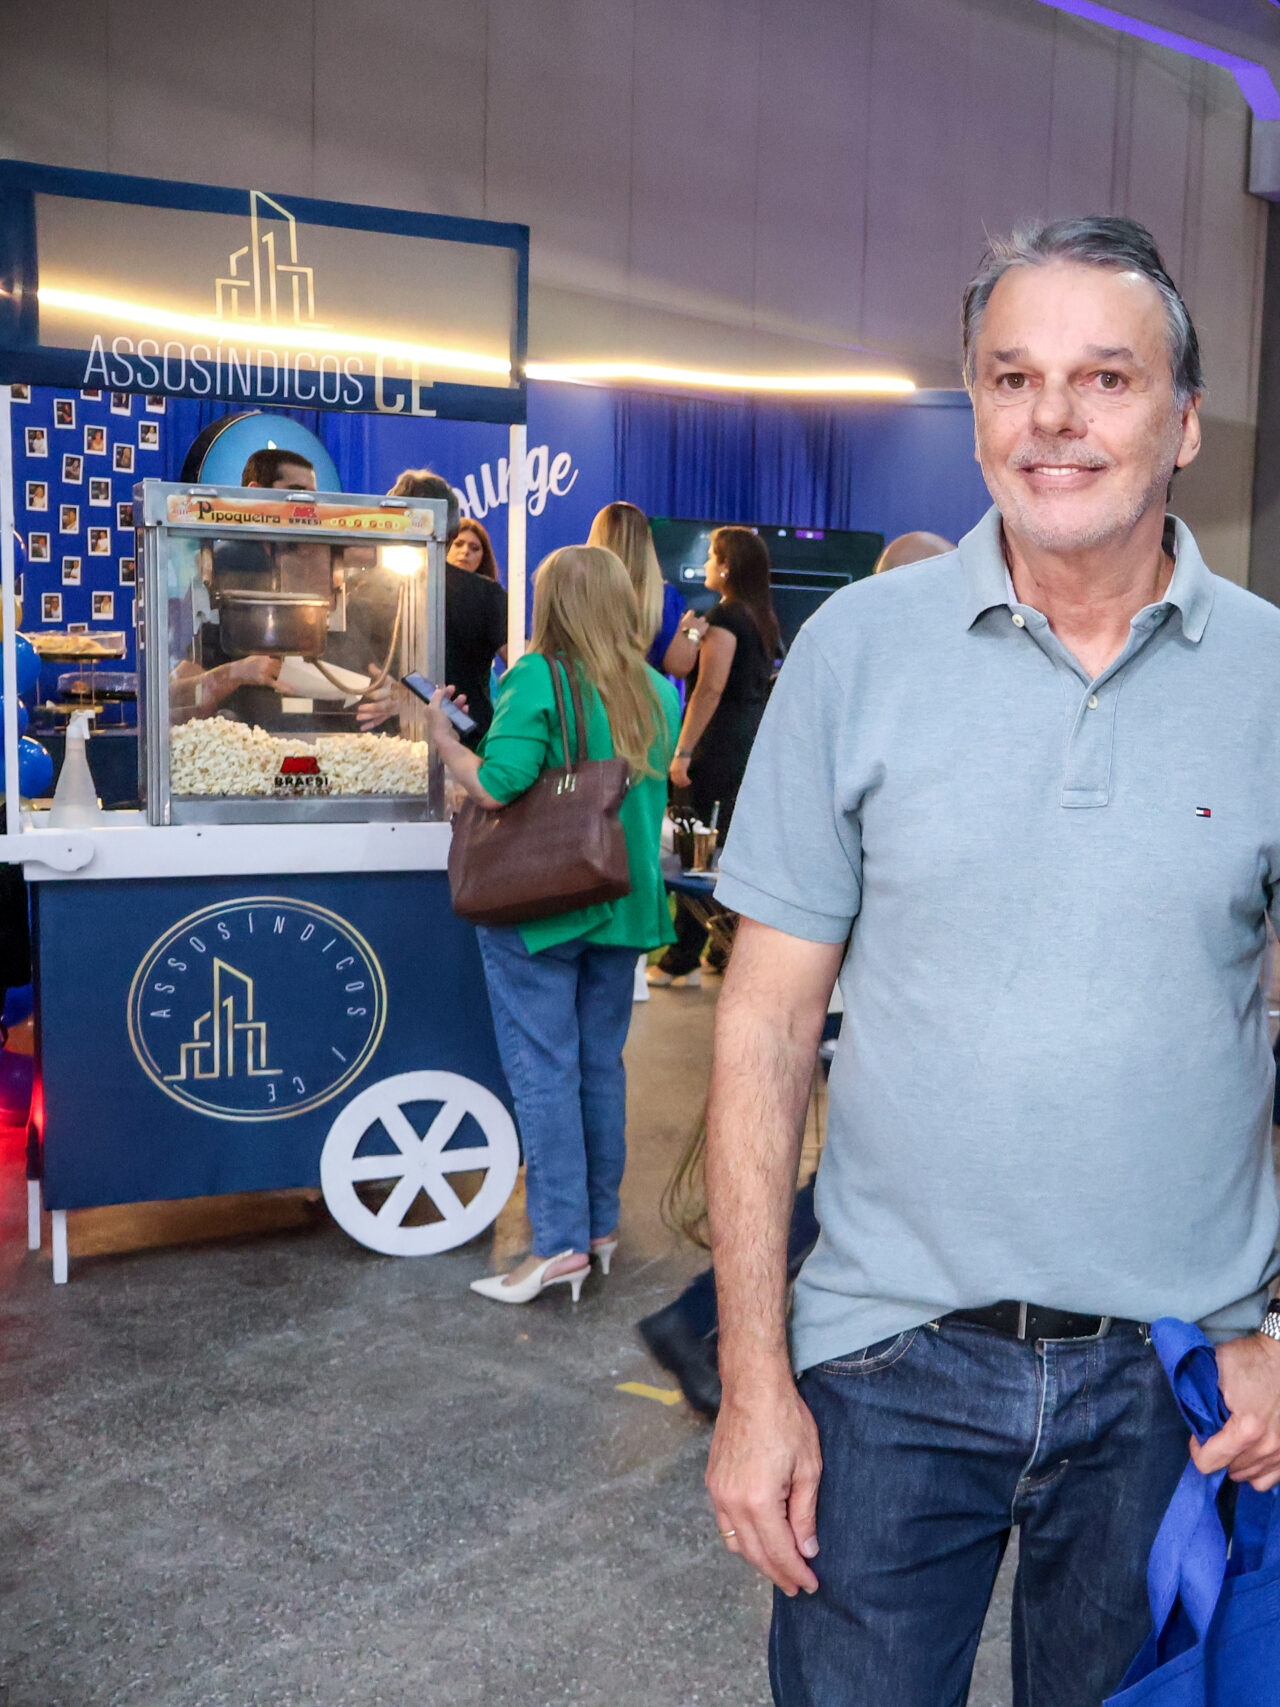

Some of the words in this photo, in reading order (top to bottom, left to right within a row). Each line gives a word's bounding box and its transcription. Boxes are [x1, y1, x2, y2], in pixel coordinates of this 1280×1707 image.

[83, 334, 364, 405] ASSOSÍNDICOS
[374, 350, 437, 417] CE
[197, 501, 281, 524] Pipoqueira
